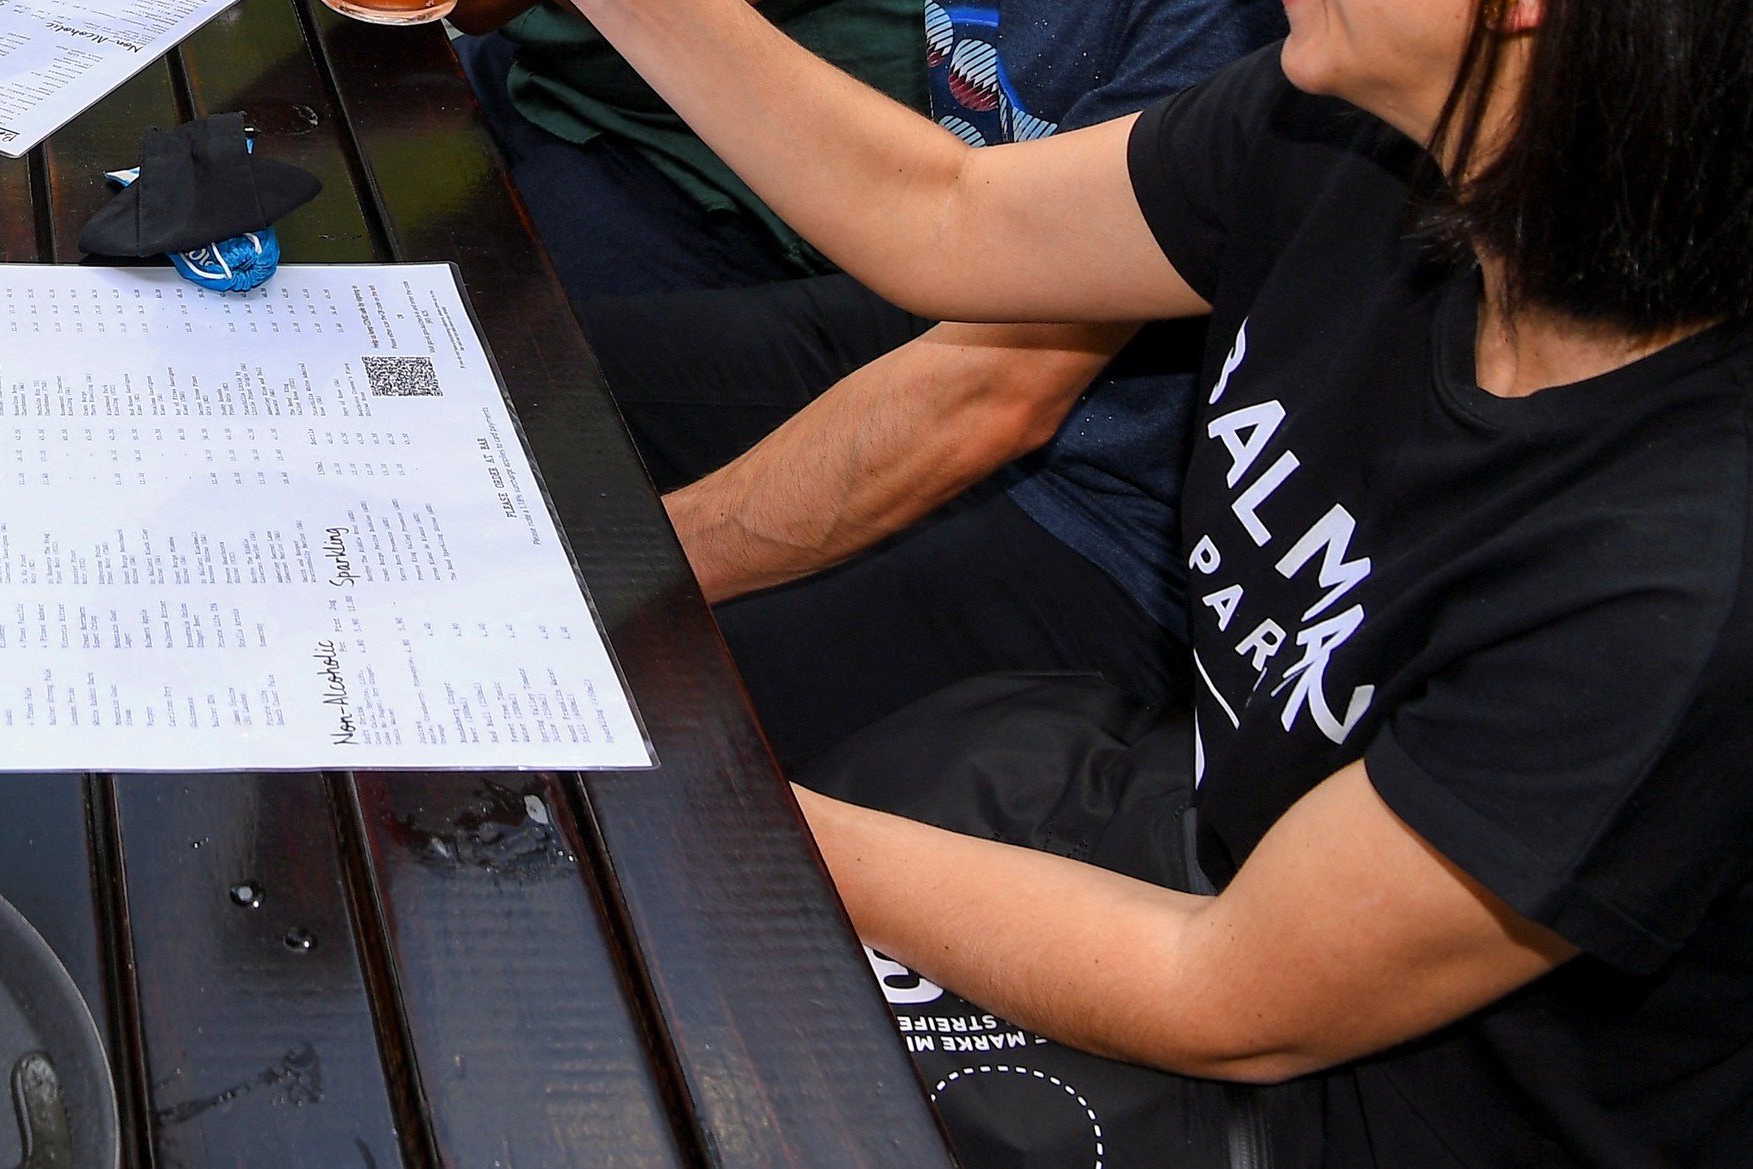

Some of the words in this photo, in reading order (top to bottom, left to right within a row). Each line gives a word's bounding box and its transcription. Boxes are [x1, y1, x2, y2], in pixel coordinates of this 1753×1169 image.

[46, 20, 144, 54] Non-Alcoholic
[482, 407, 498, 432] payments
[477, 438, 490, 450] BAR
[489, 432, 501, 443] card
[483, 454, 495, 464] AT
[498, 449, 511, 468] applies
[488, 467, 505, 489] ORDER
[498, 493, 517, 518] PLEASE
[322, 527, 361, 587] Sparkling
[1188, 533, 1288, 690] PAR
[313, 640, 356, 745] Non-Alcoholic
[943, 1030, 1026, 1052] MARKE
